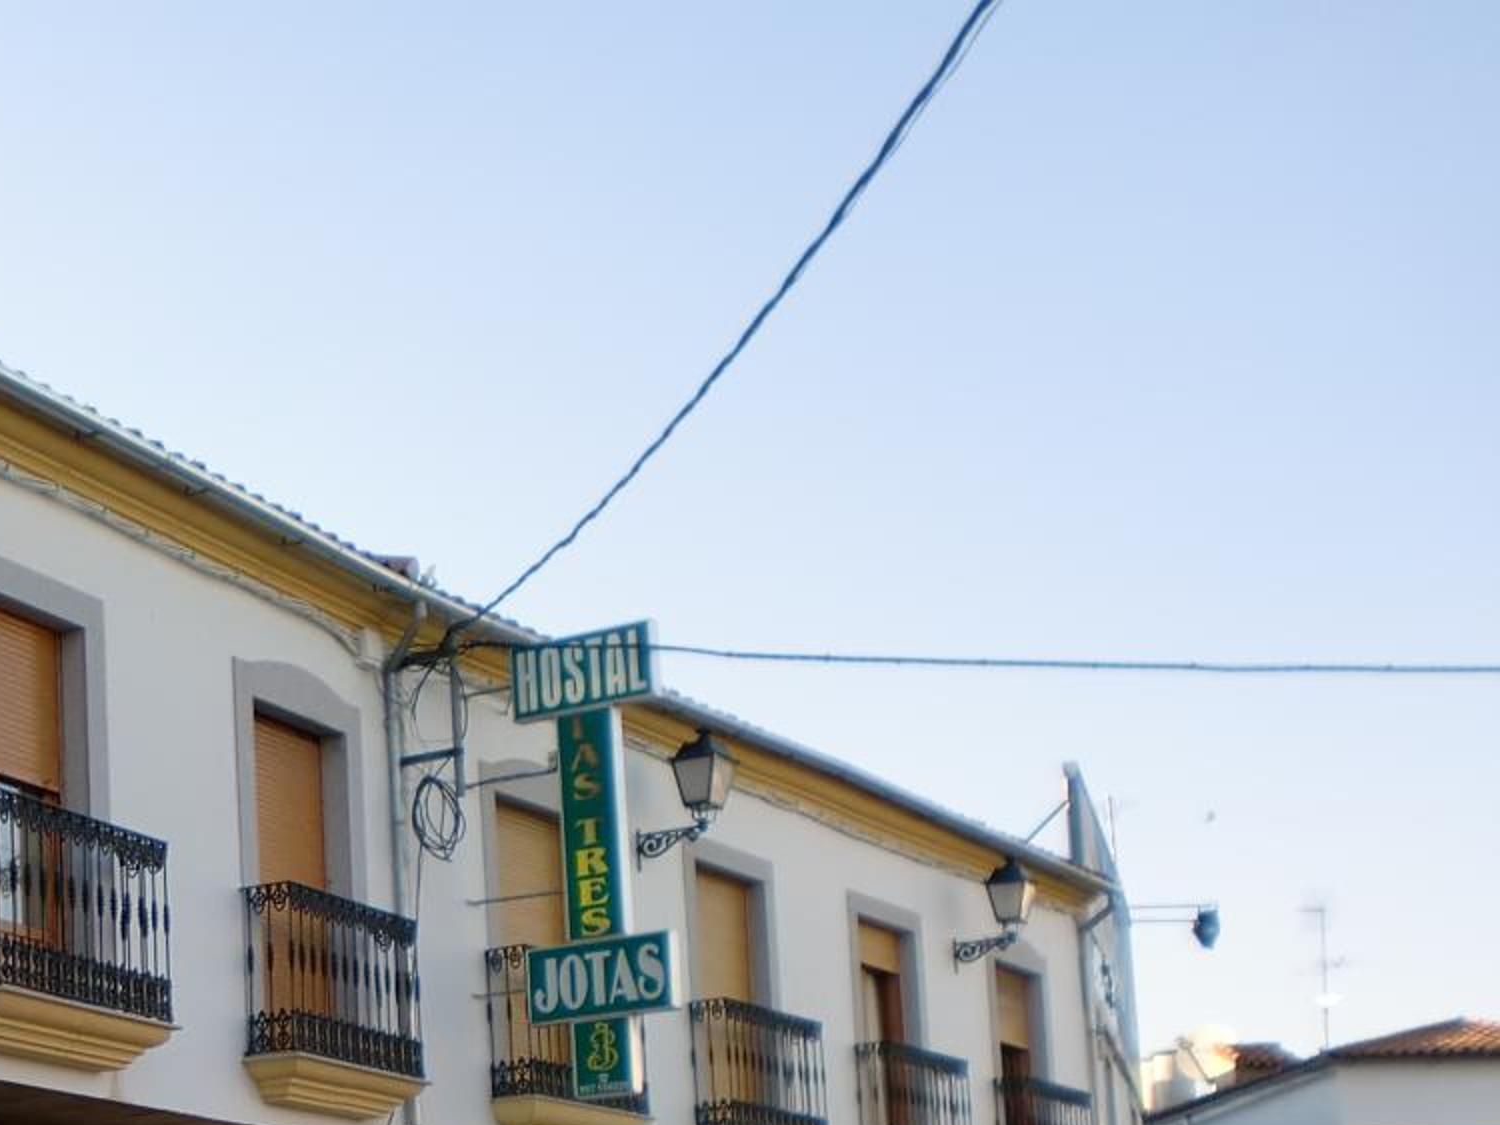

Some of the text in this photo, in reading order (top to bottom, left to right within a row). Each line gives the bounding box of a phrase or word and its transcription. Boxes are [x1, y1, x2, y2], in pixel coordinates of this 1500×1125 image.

[516, 628, 647, 714] HOSTAL
[573, 817, 612, 937] TRES
[534, 943, 665, 1013] JOTAS
